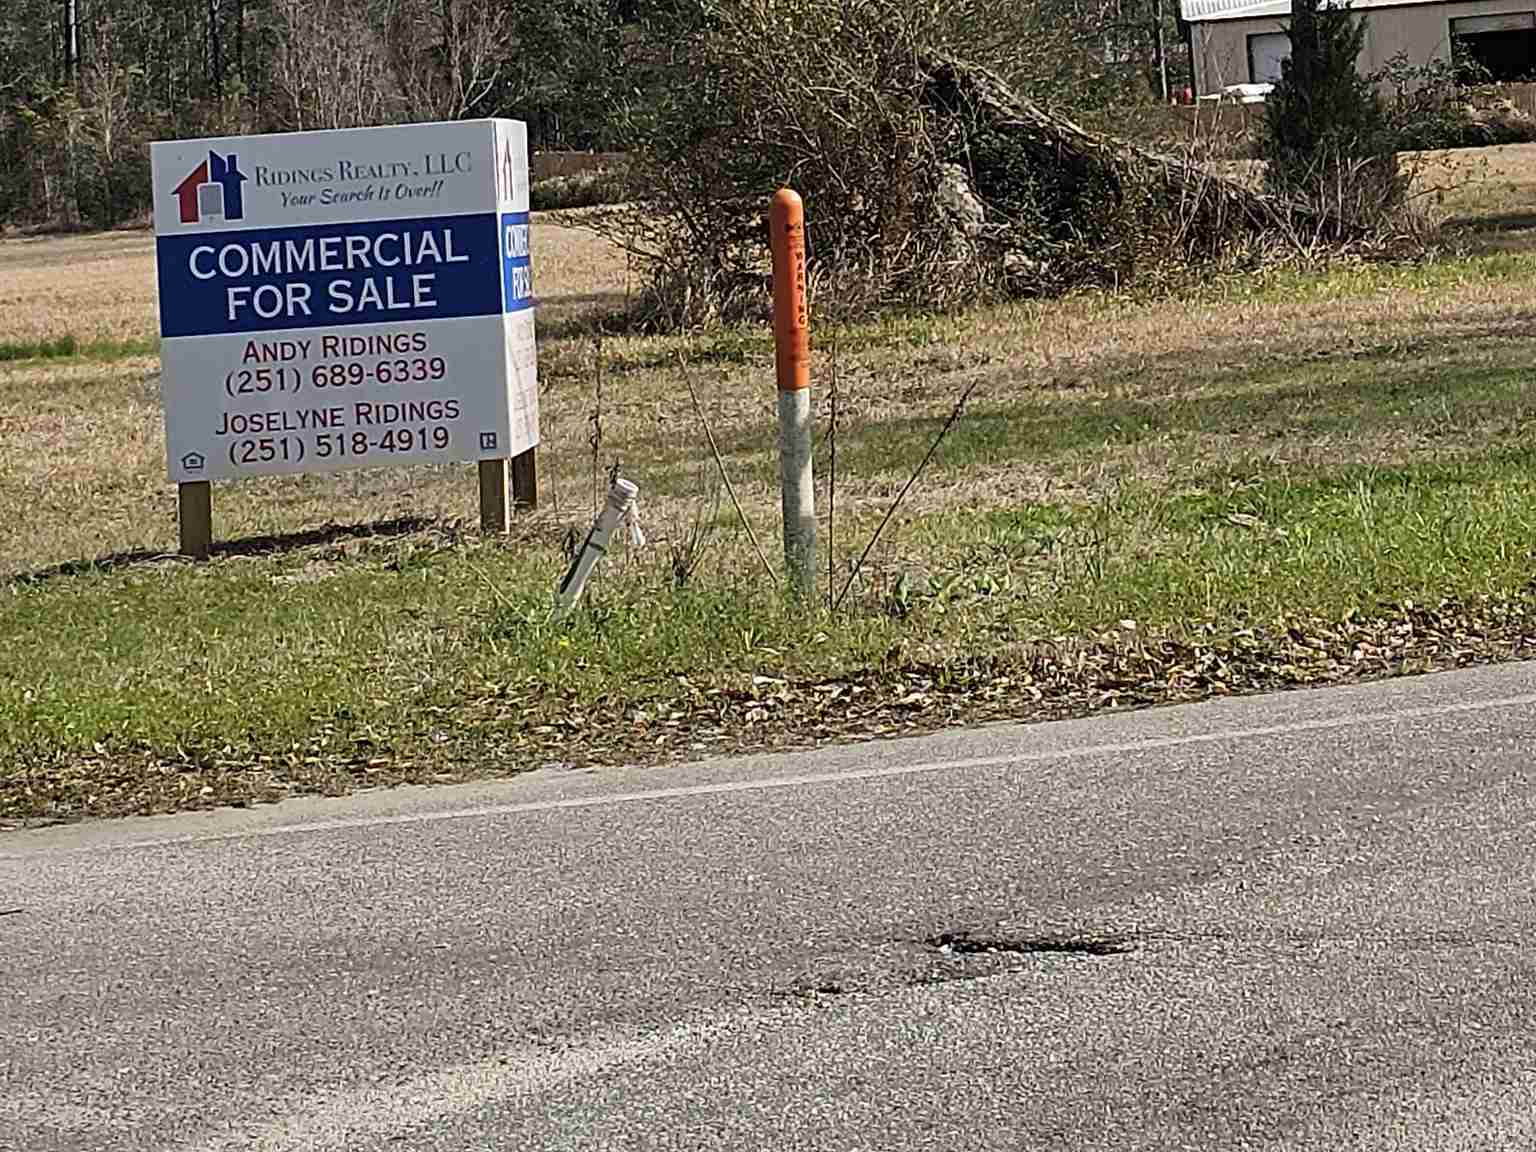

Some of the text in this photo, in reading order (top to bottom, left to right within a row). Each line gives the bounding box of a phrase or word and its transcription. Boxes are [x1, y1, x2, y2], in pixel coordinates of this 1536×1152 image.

[255, 164, 334, 188] RIDINGS
[424, 151, 472, 175] LLC
[280, 180, 444, 208] Your Search Is Over!!
[189, 228, 469, 280] COMMERCIAL
[226, 273, 438, 320] FOR SALE
[243, 332, 427, 364] ANDY RIDINGS
[225, 357, 446, 397] (251) 689-6339
[215, 399, 460, 435] JOSELYNE RIDINGS
[229, 426, 449, 466] (251) 518-4919
